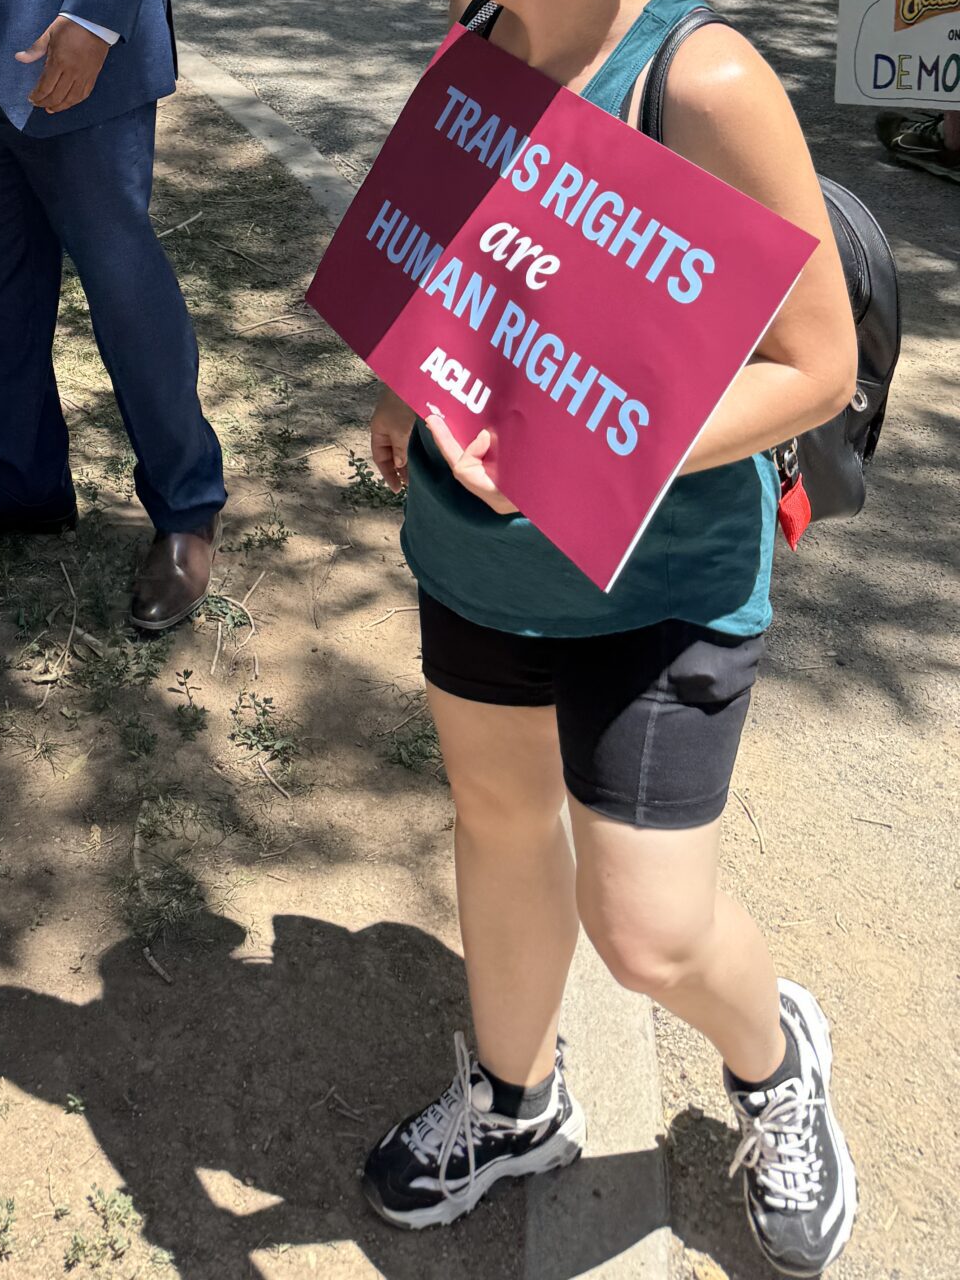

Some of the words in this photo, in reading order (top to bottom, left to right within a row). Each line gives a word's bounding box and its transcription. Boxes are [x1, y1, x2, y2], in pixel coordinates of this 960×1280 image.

[872, 53, 960, 93] DEMO
[433, 85, 550, 193] TRANS
[540, 162, 716, 304] RIGHTS
[479, 221, 561, 291] are
[366, 199, 496, 332] HUMAN
[490, 300, 650, 457] RIGHTS
[420, 346, 492, 414] ACLU
